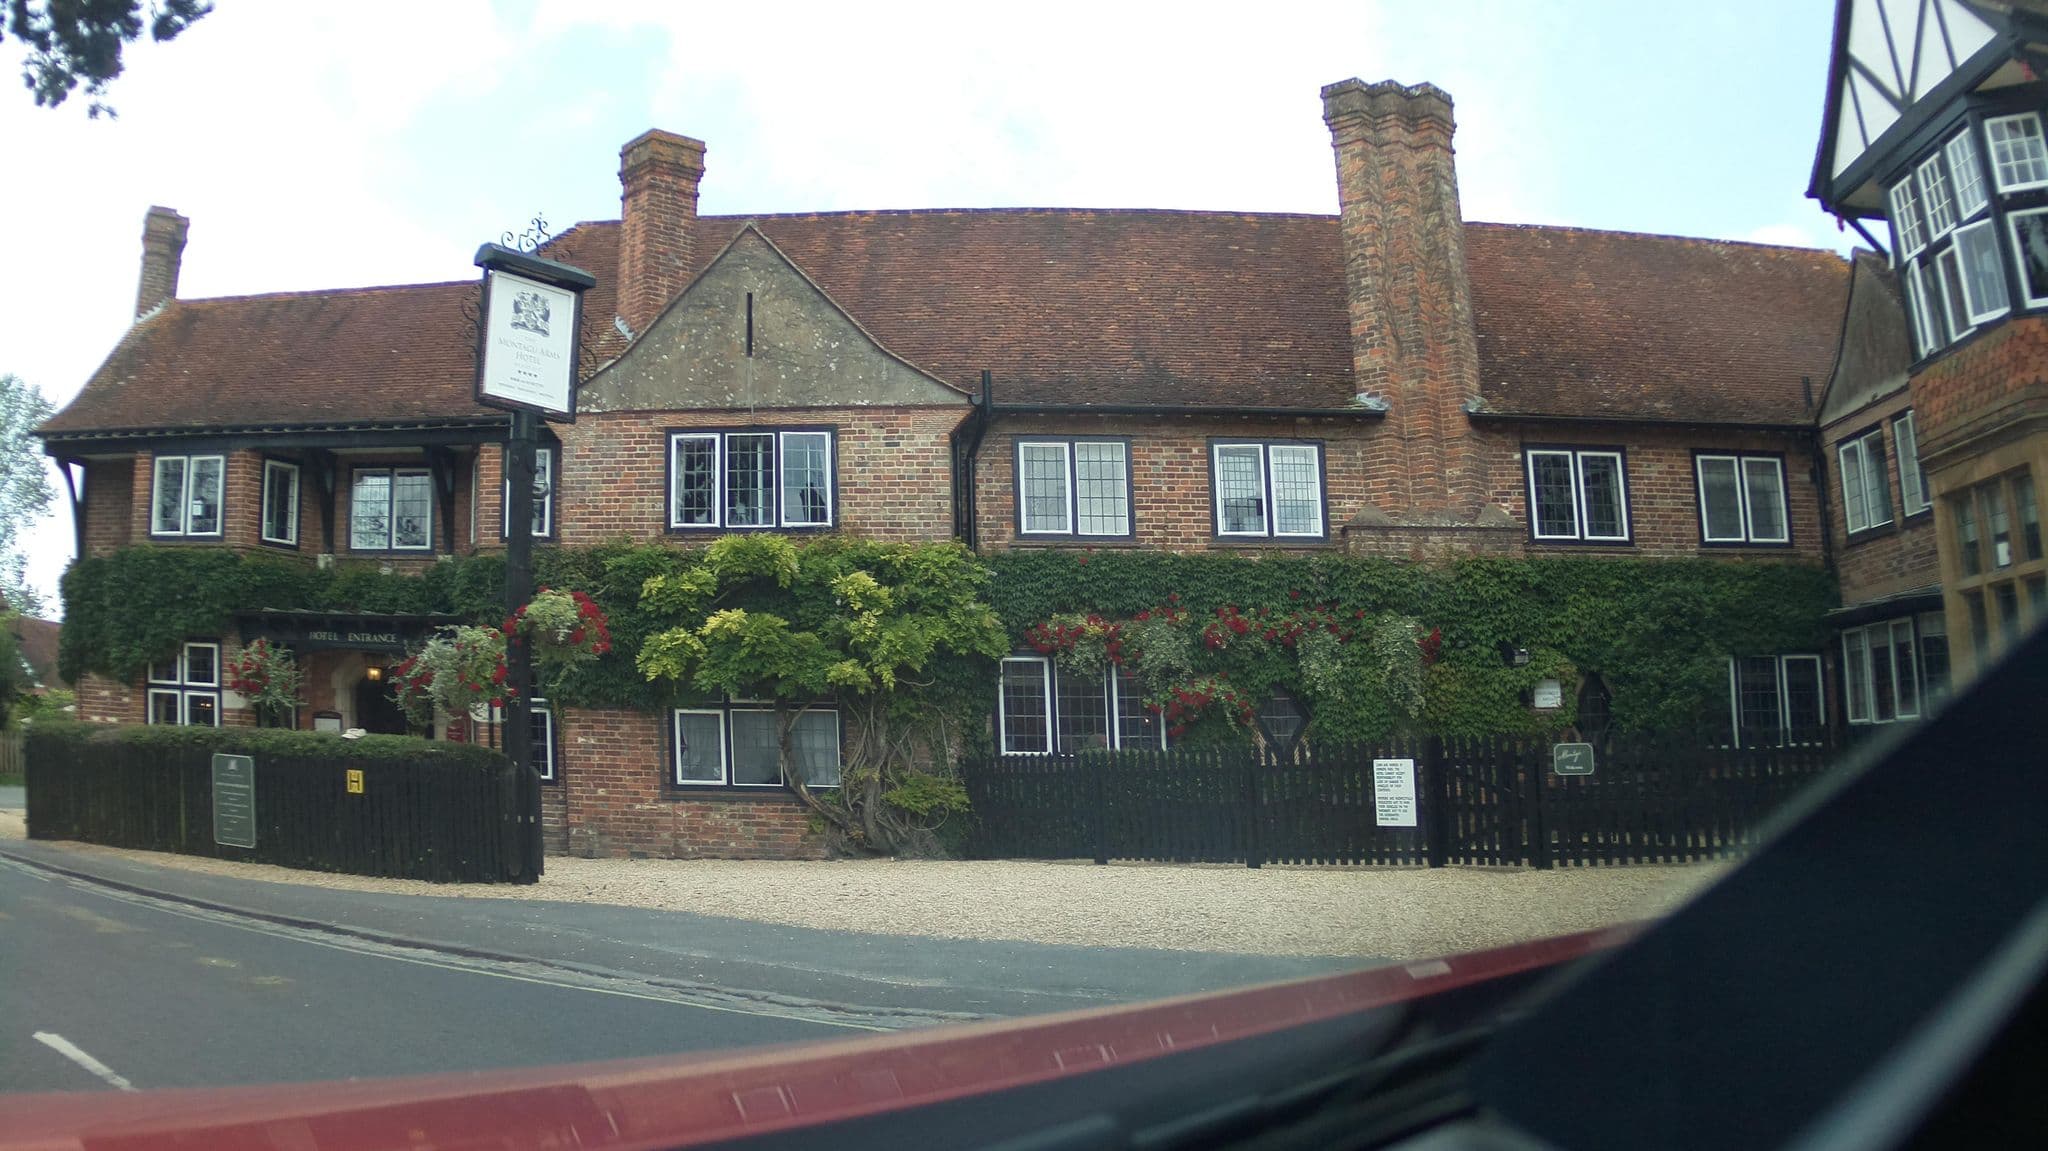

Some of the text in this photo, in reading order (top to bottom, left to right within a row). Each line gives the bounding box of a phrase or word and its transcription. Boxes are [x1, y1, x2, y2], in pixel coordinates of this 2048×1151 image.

[515, 351, 541, 365] HOTEL
[539, 346, 560, 360] ARMS
[308, 631, 398, 643] HOTEL ENTRANCE
[349, 771, 360, 792] H
